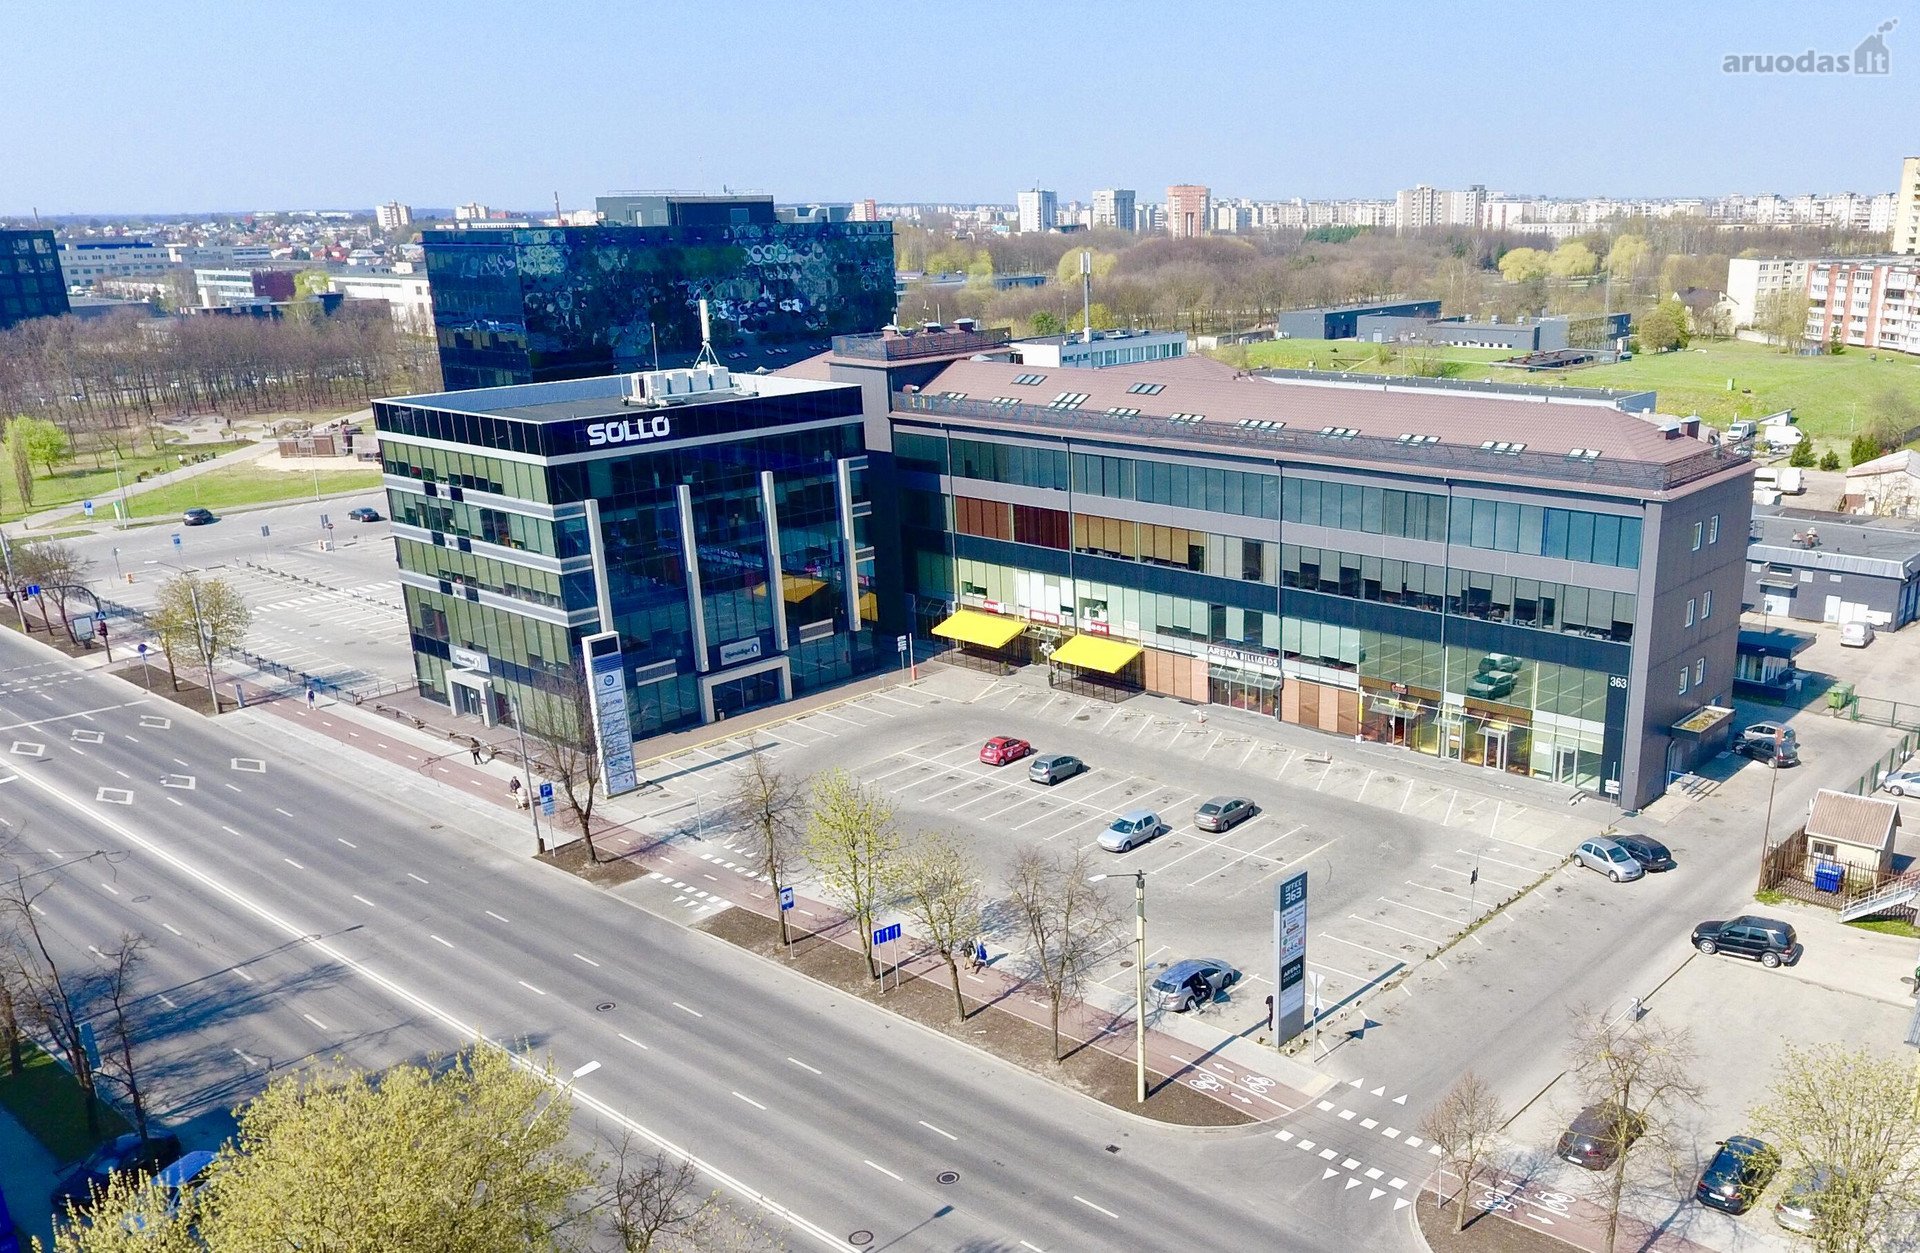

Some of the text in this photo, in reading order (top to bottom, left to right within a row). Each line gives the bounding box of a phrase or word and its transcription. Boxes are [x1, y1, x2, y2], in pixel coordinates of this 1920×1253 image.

[587, 416, 670, 446] SOLLO
[1207, 646, 1279, 667] ARENA BILLIARDS
[1610, 676, 1627, 689] 363
[1285, 879, 1303, 893] OFFICE
[1285, 886, 1302, 905] 363
